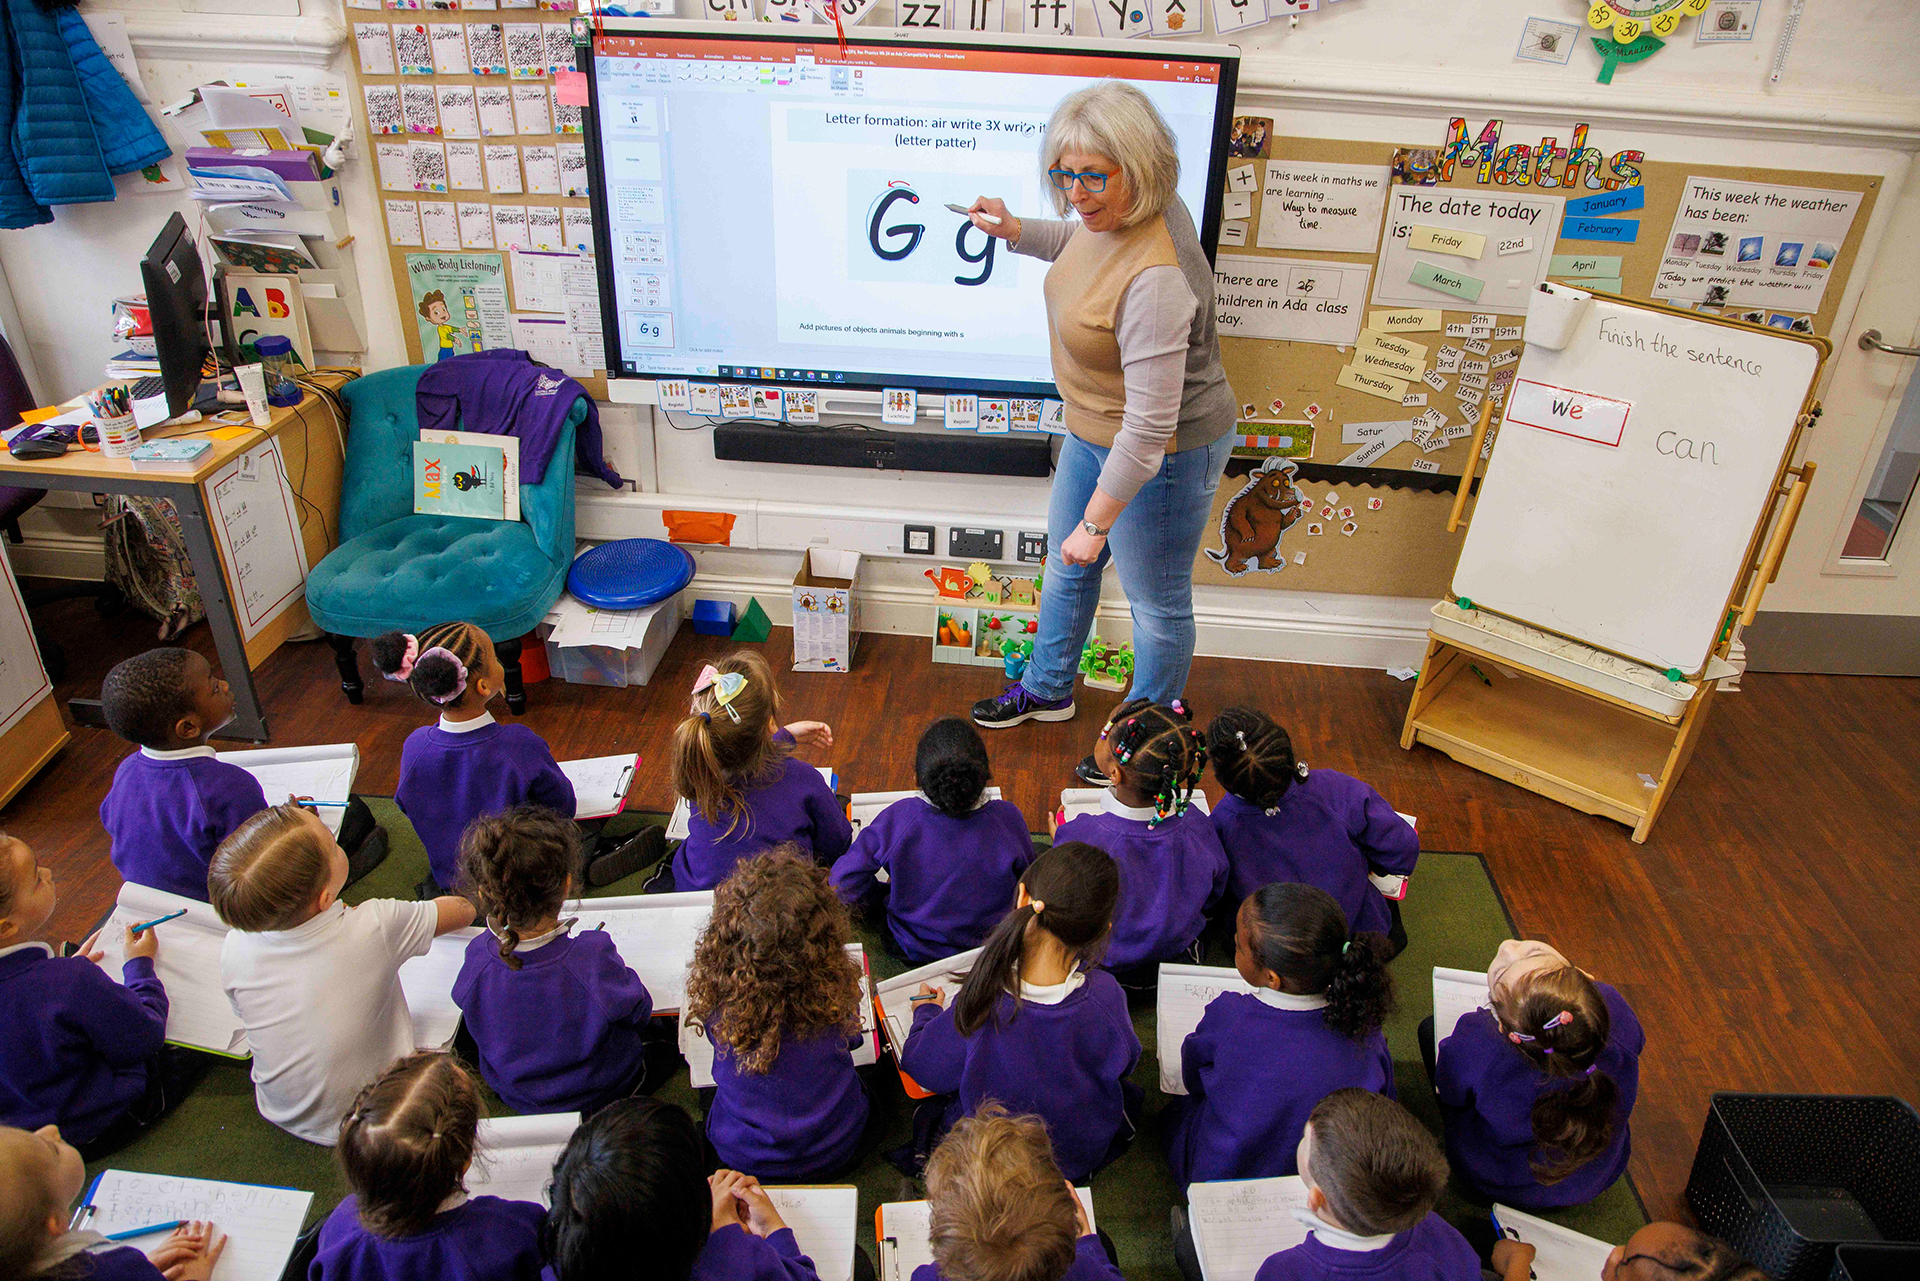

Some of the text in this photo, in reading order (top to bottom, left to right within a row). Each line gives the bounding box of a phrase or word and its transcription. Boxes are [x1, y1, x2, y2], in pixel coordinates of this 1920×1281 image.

[902, 3, 941, 27] zz
[825, 112, 861, 126] Letter
[864, 114, 927, 129] formation:
[931, 117, 947, 129] air
[950, 118, 981, 131] write
[986, 119, 1001, 131] 3X
[894, 134, 977, 151] (letter patter)
[1438, 117, 1645, 191] Maths
[1270, 170, 1378, 188] This week in maths we
[1265, 187, 1324, 202] are learning
[1693, 186, 1848, 213] This week the weather
[1282, 200, 1357, 217] Ways to measure
[1398, 194, 1541, 225] The date today
[1582, 195, 1627, 212] January
[1684, 205, 1749, 223] has been:
[869, 188, 925, 261] G
[1299, 219, 1322, 230] time.
[1392, 222, 1412, 238] is:
[1577, 223, 1623, 236] February
[1431, 234, 1524, 251] Friday 22nd
[411, 258, 501, 276] Whole Body Listening!
[1572, 260, 1597, 272] April
[1664, 258, 1824, 280] Monday Tuesday Wednesday Thursday Friday
[1214, 272, 1279, 288] There are
[1432, 273, 1462, 289] March
[1661, 272, 1687, 286] Today
[1708, 274, 1737, 285] predict
[1740, 277, 1755, 286] the
[1759, 280, 1792, 290] weather
[1794, 282, 1812, 291] will
[1215, 293, 1349, 314] hildren in Ada class
[1386, 316, 1424, 326] Monday
[1472, 314, 1489, 324] 5th
[652, 326, 660, 338] g
[815, 324, 842, 333] pictures
[852, 326, 878, 335] objects
[879, 327, 906, 335] animals
[908, 328, 943, 338] beginning
[944, 330, 958, 338] with
[1446, 325, 1464, 334] 4th
[1496, 328, 1517, 337] 19th
[1375, 337, 1411, 356] Tuesday
[1440, 345, 1458, 358] 2nd
[1465, 338, 1486, 351] 12th
[1599, 316, 1763, 378] Finish the sentence
[1364, 354, 1415, 374] Wednesday
[1437, 359, 1454, 369] 3rd
[1462, 361, 1483, 370] 14th
[1354, 373, 1394, 392] Thursday
[1424, 370, 1442, 386] 21st
[1461, 373, 1482, 385] 15th
[1403, 394, 1420, 403] 6th
[1457, 386, 1478, 400] 16th
[1425, 407, 1441, 421] 7th
[1462, 402, 1478, 420] 13th
[1412, 418, 1429, 427] 8th
[1444, 426, 1465, 436] 18th
[1356, 440, 1386, 463] Sunday
[1423, 438, 1444, 450] 10th
[1413, 459, 1433, 470] 31st
[423, 457, 441, 500] Max
